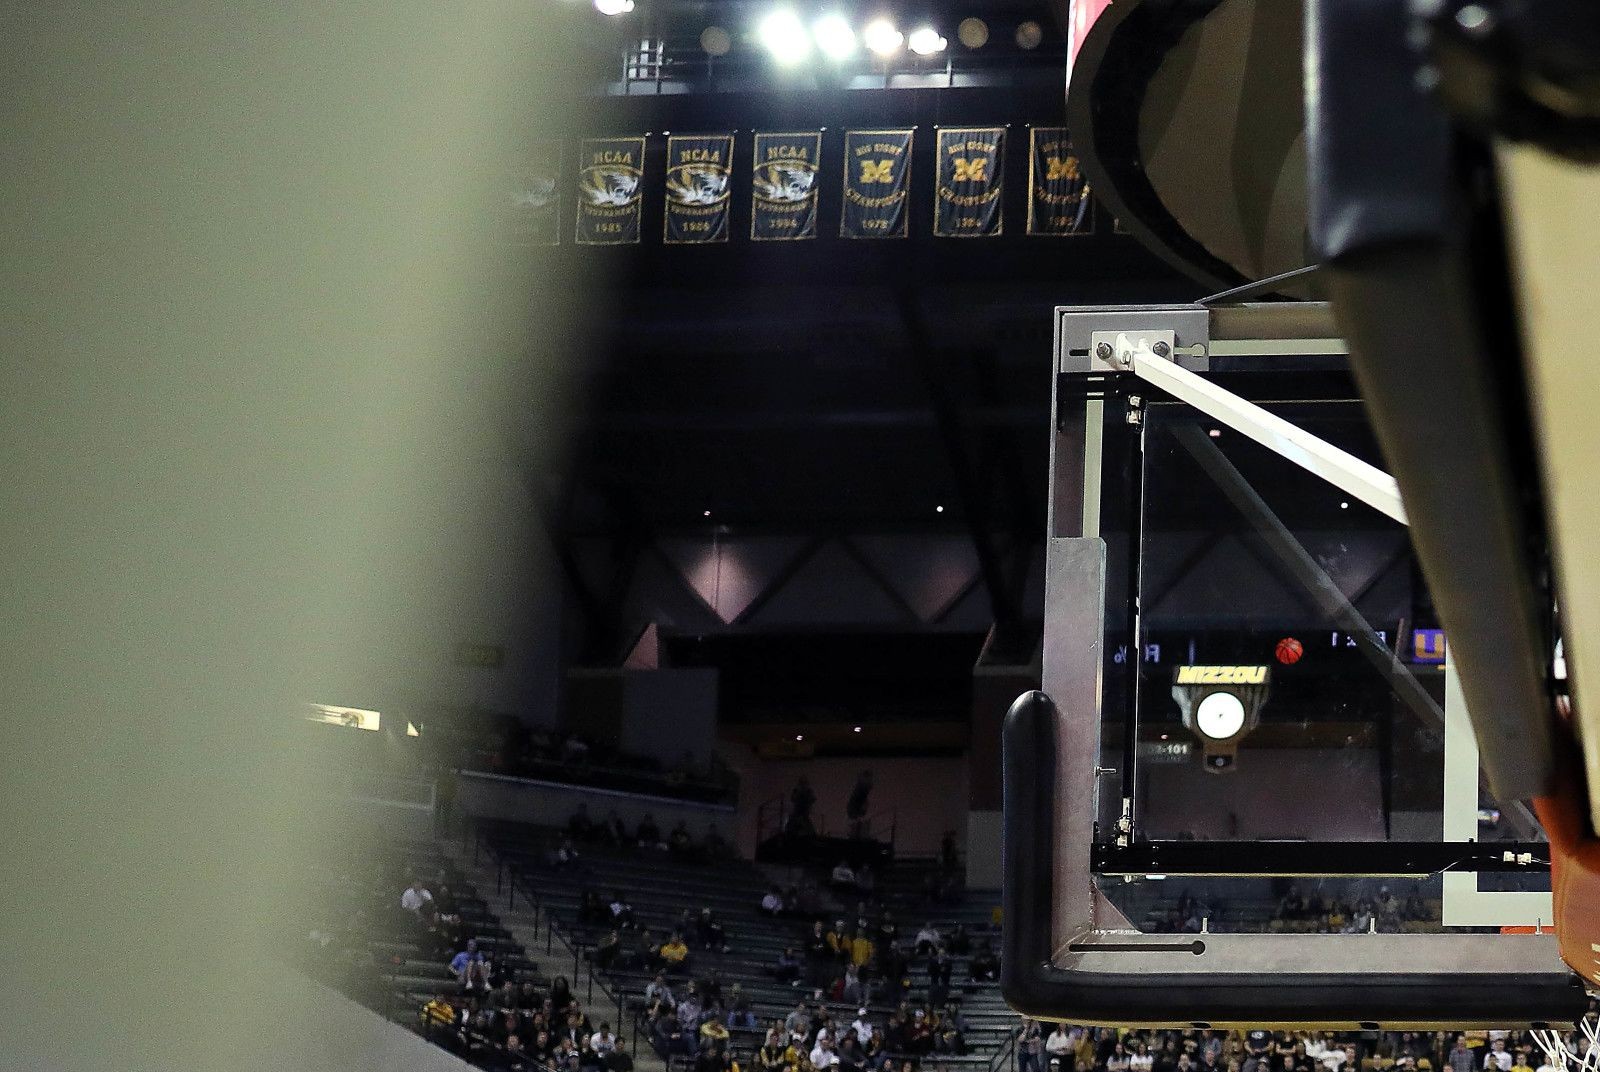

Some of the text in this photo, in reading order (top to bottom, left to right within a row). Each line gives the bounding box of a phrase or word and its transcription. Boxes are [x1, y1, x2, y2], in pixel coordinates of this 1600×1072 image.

[593, 150, 633, 164] NCAA
[680, 149, 720, 162] NCAA
[767, 145, 807, 159] NCAA
[1177, 666, 1267, 684] MIZZOU
